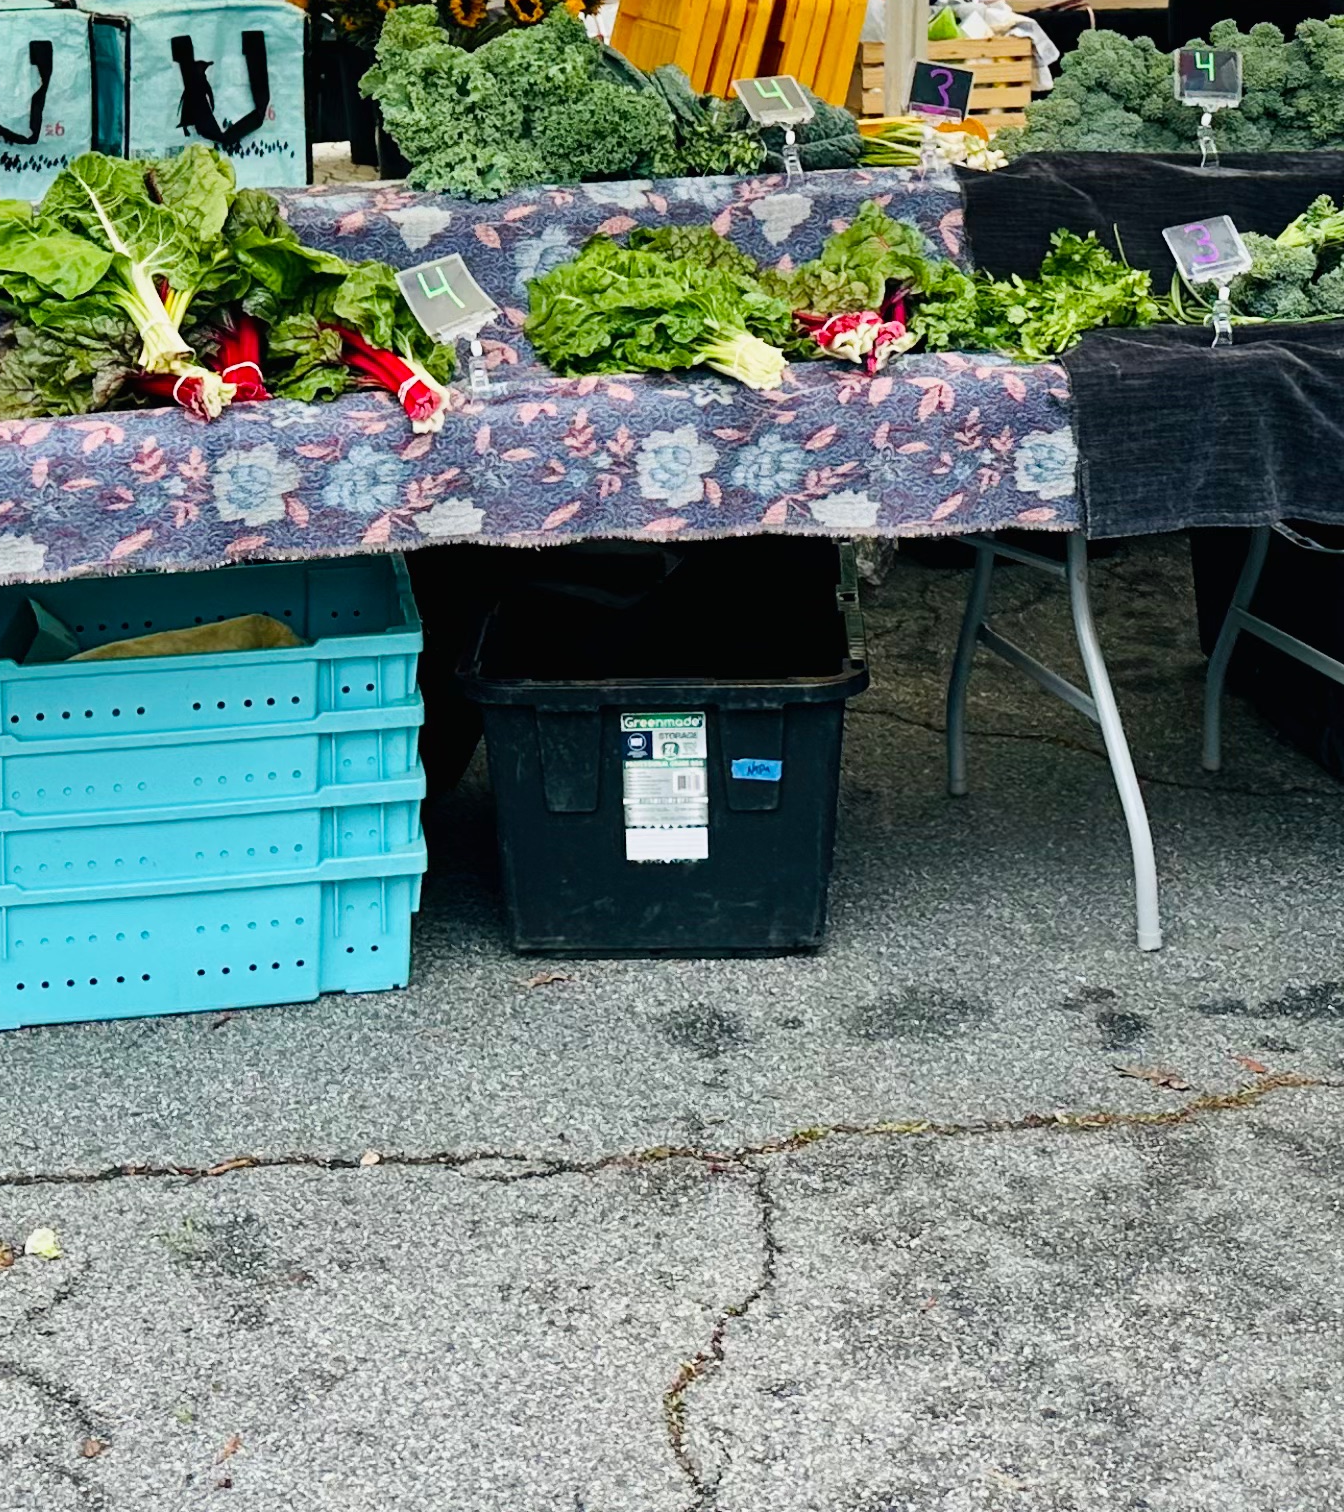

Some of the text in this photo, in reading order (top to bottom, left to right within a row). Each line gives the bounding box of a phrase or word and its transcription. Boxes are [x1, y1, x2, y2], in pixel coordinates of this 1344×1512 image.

[1195, 51, 1216, 82] 4
[753, 78, 794, 111] 4
[922, 68, 954, 113] 3
[1183, 223, 1220, 264] 3
[416, 266, 466, 309] 4
[624, 715, 701, 729] Greenmade
